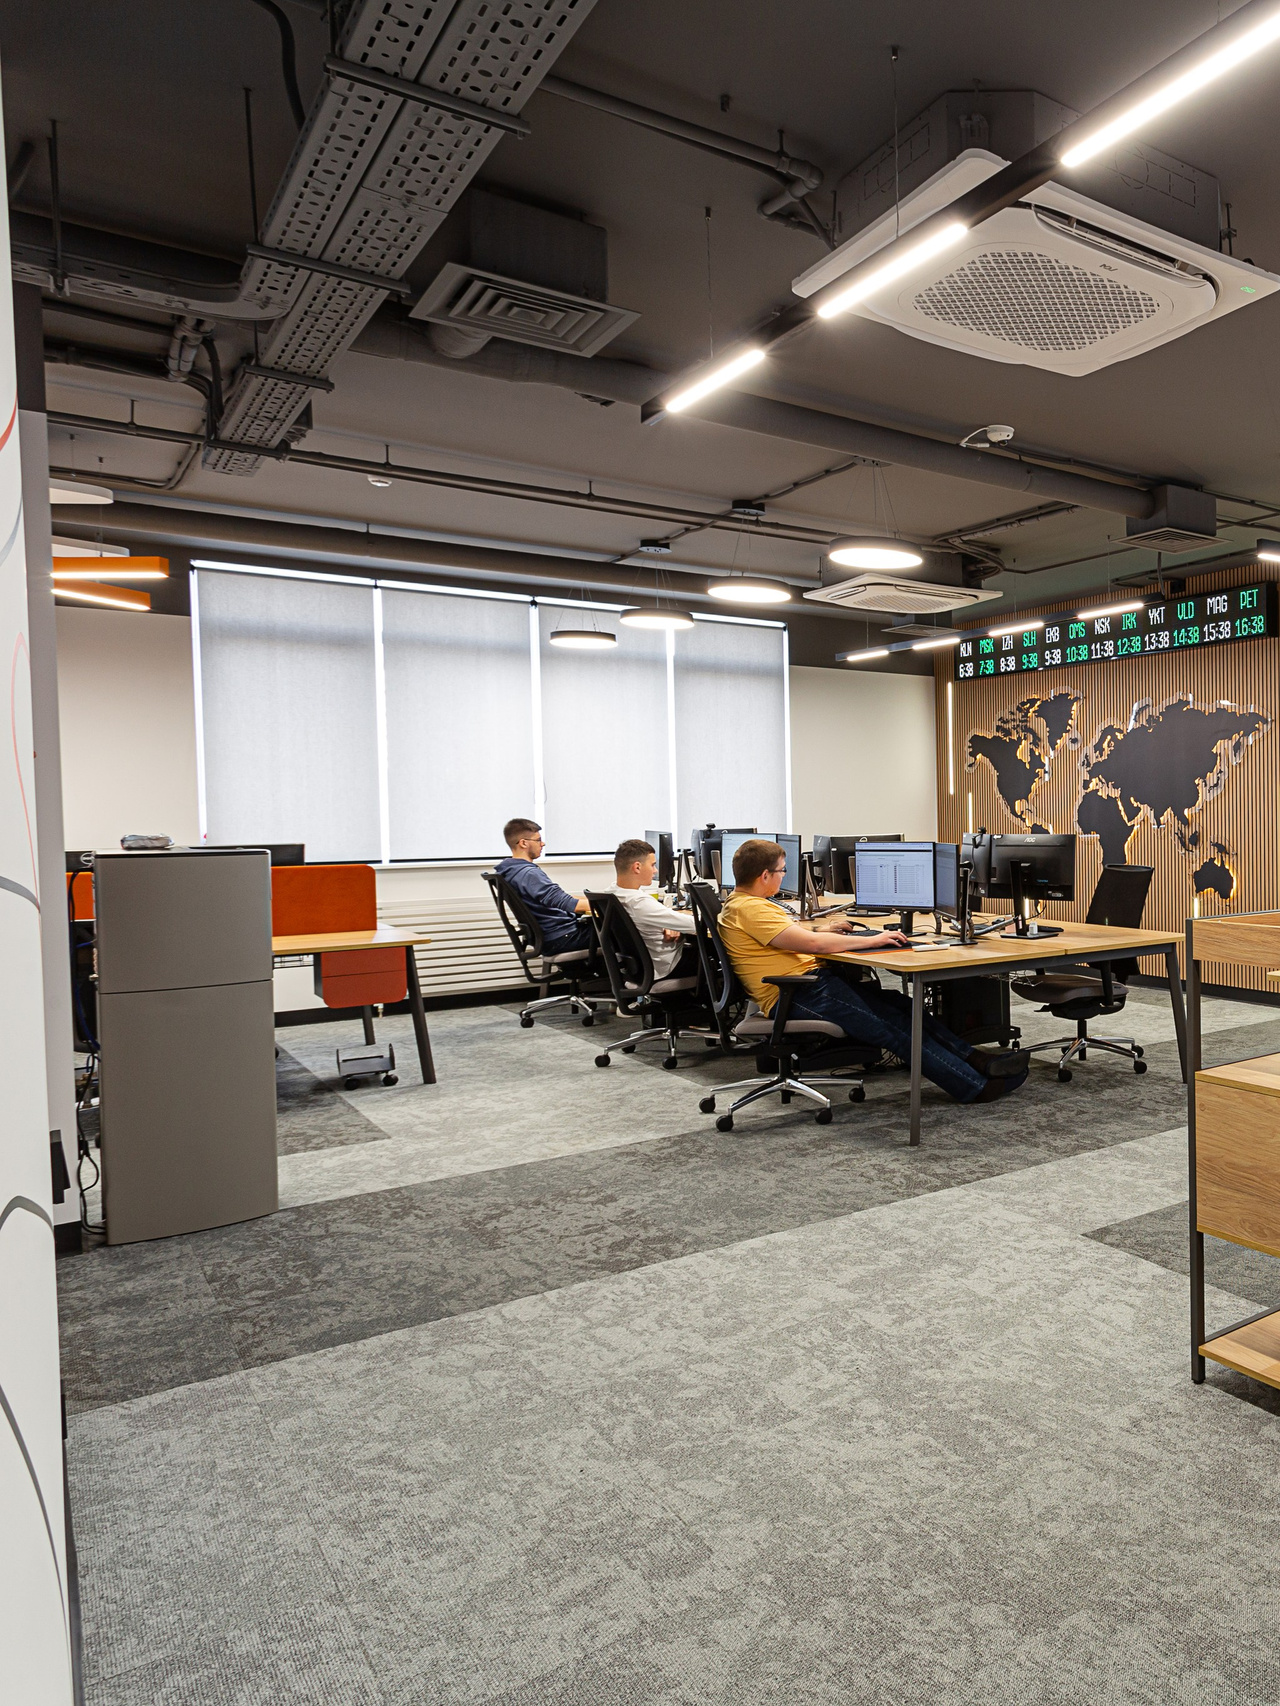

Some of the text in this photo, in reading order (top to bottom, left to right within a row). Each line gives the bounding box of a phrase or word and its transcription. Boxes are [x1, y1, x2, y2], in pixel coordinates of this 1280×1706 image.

[979, 638, 994, 654] MSK
[1046, 626, 1060, 643] EKB
[1068, 621, 1086, 639] OMS
[1094, 617, 1111, 635] NSK
[1121, 612, 1137, 630] IRK
[1148, 607, 1165, 625] YKT
[1177, 601, 1194, 620] VLD
[1206, 595, 1228, 615] MAG
[1240, 589, 1259, 609] PET
[979, 659, 994, 675] 7:38
[1000, 656, 1016, 672] 8:38
[1022, 652, 1038, 669] 9:38
[1044, 648, 1061, 665] 9:38
[1066, 644, 1088, 662] 10:38
[1091, 640, 1114, 659] 11:38
[1117, 635, 1141, 655] 12:38
[1144, 631, 1170, 650] 13:38
[1173, 626, 1200, 646] 14:38
[1203, 620, 1231, 641] 15:38
[1235, 615, 1264, 637] 16:38
